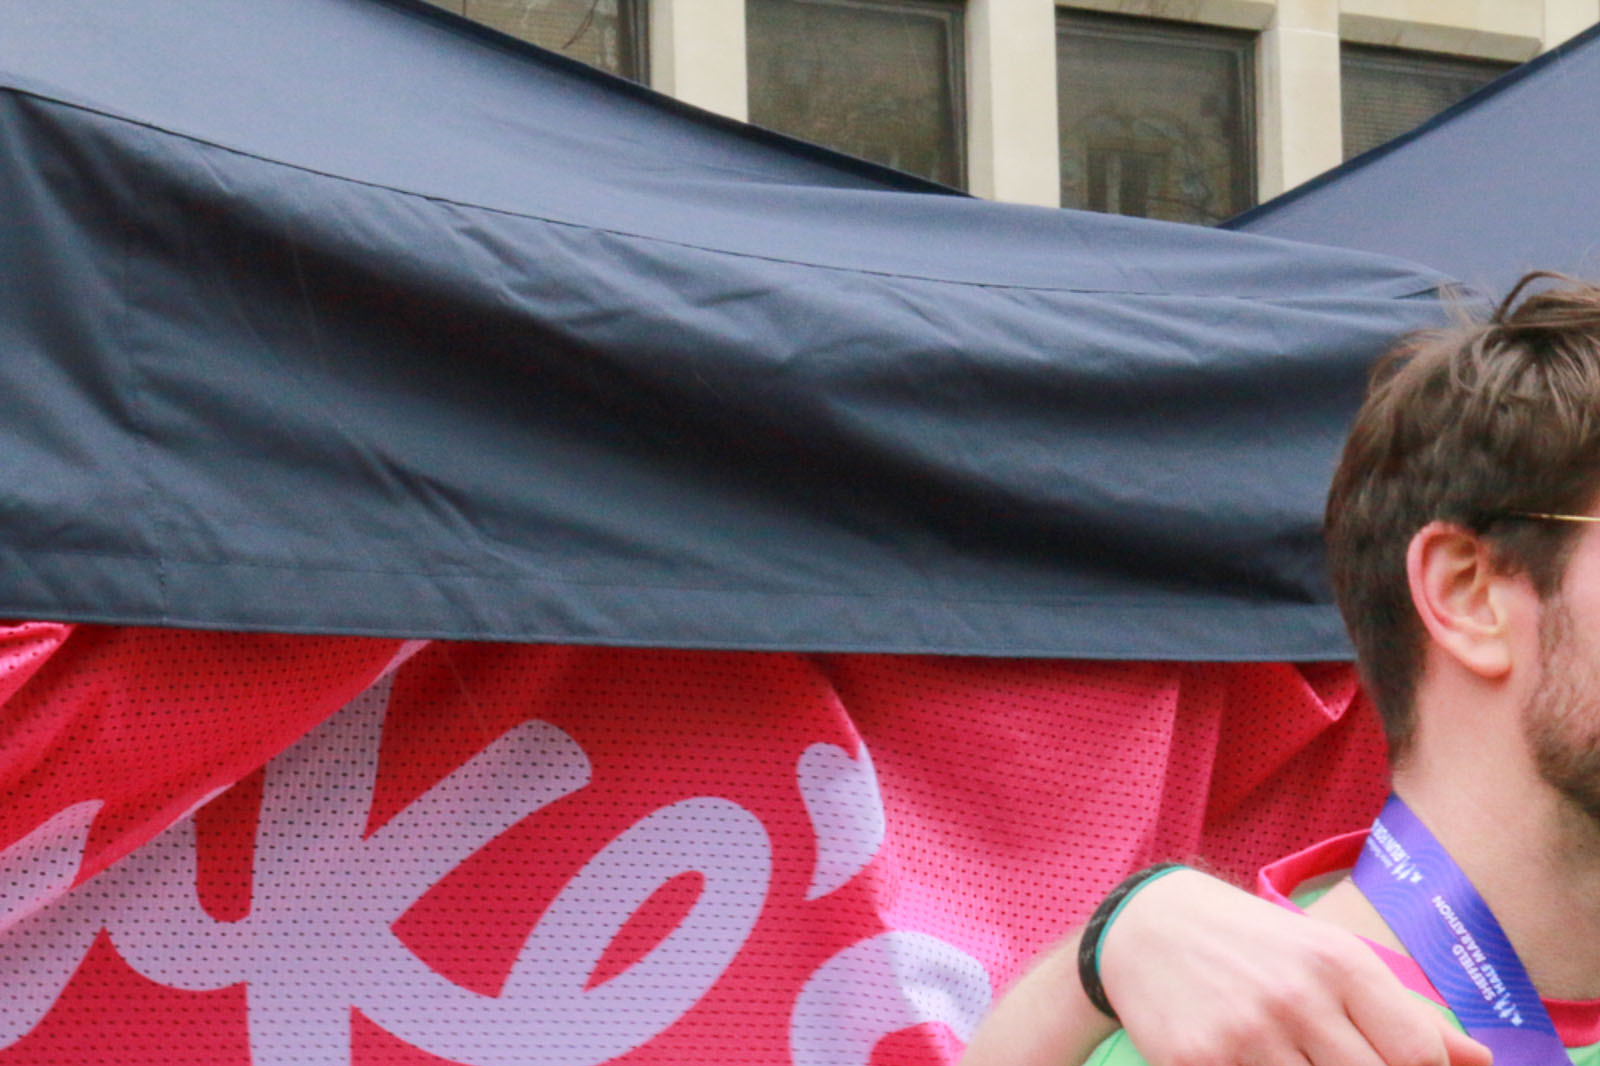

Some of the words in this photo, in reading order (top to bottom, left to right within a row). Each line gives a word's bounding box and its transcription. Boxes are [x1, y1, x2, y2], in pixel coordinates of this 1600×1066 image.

[1432, 895, 1486, 963] MARATHON
[1452, 944, 1497, 1001] SHEFFIELD
[1482, 963, 1507, 995] HALF
